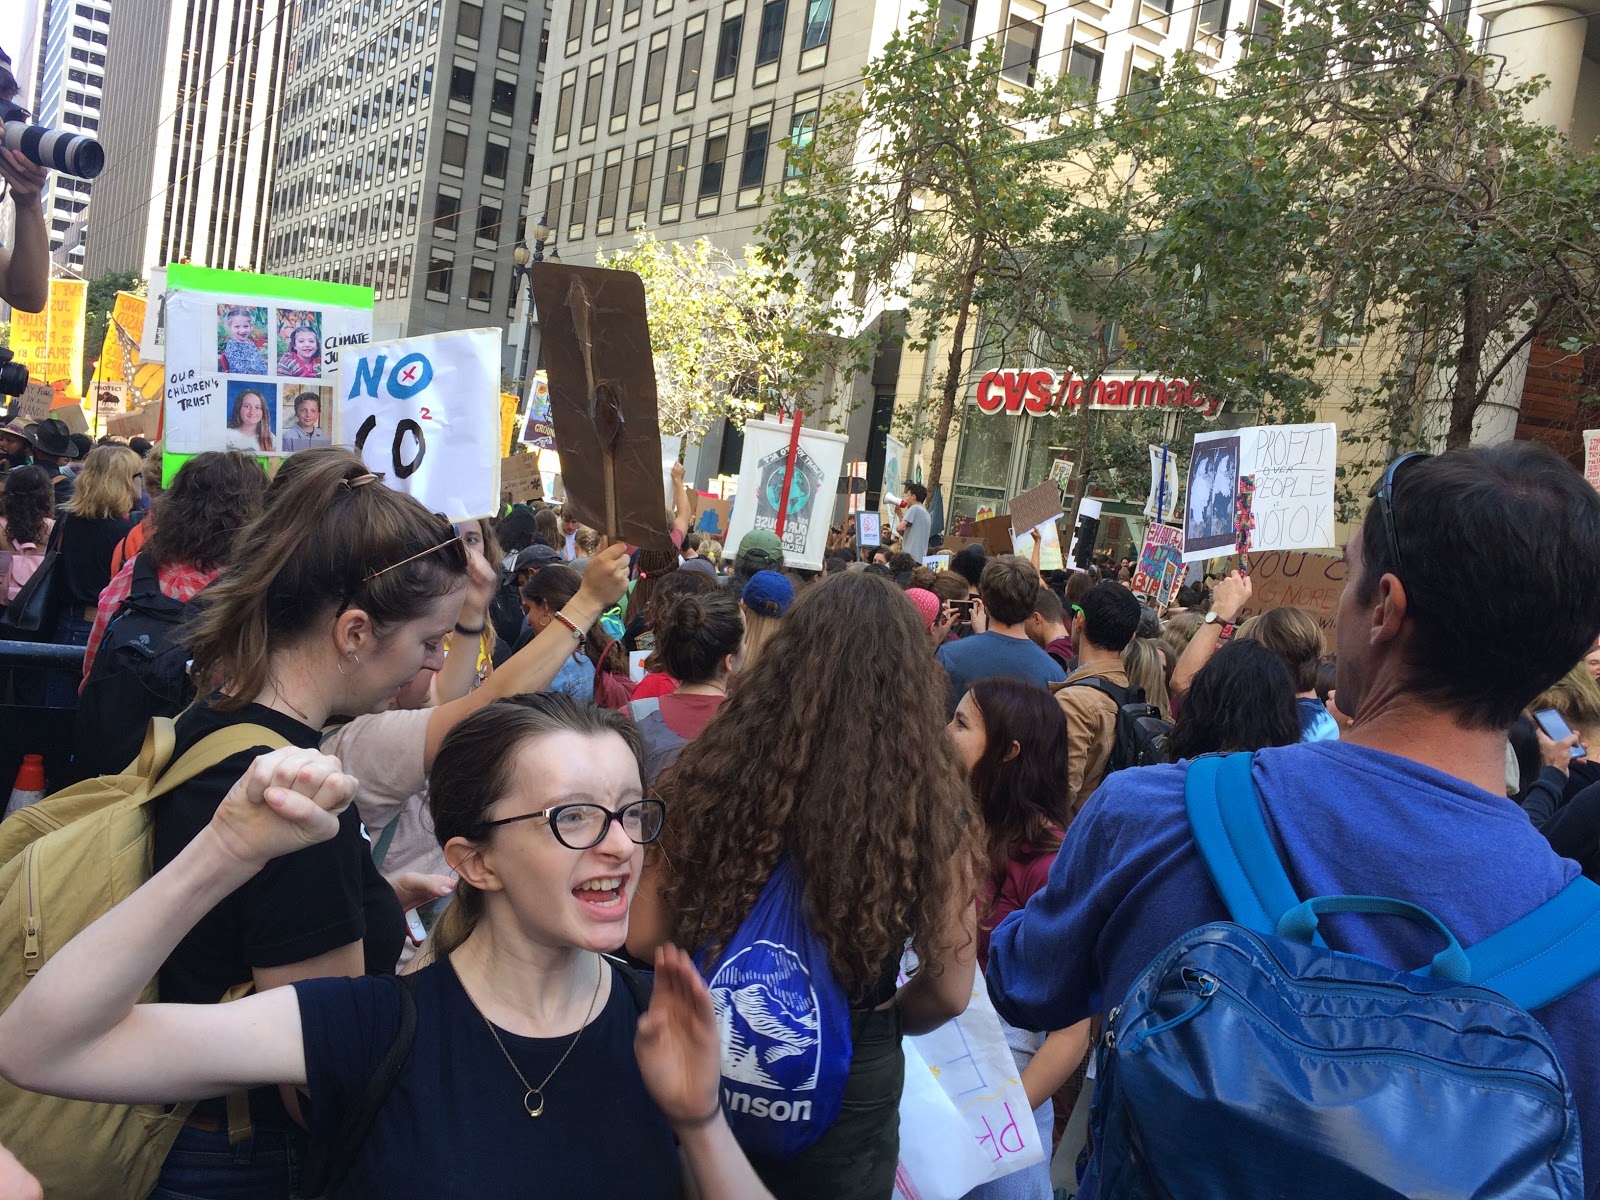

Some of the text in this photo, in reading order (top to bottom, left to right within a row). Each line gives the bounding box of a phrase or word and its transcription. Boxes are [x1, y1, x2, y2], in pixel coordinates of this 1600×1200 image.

[170, 369, 195, 384] OUR
[348, 353, 433, 400] NO
[177, 393, 212, 411] TRUST
[534, 423, 556, 438] GROUN
[1254, 428, 1331, 468] PROFIT
[1262, 465, 1294, 476] OVER
[1253, 475, 1327, 499] PEOPLE
[1288, 504, 1330, 548] OK
[1247, 550, 1308, 578] YOU
[1257, 580, 1336, 610] GNORE
